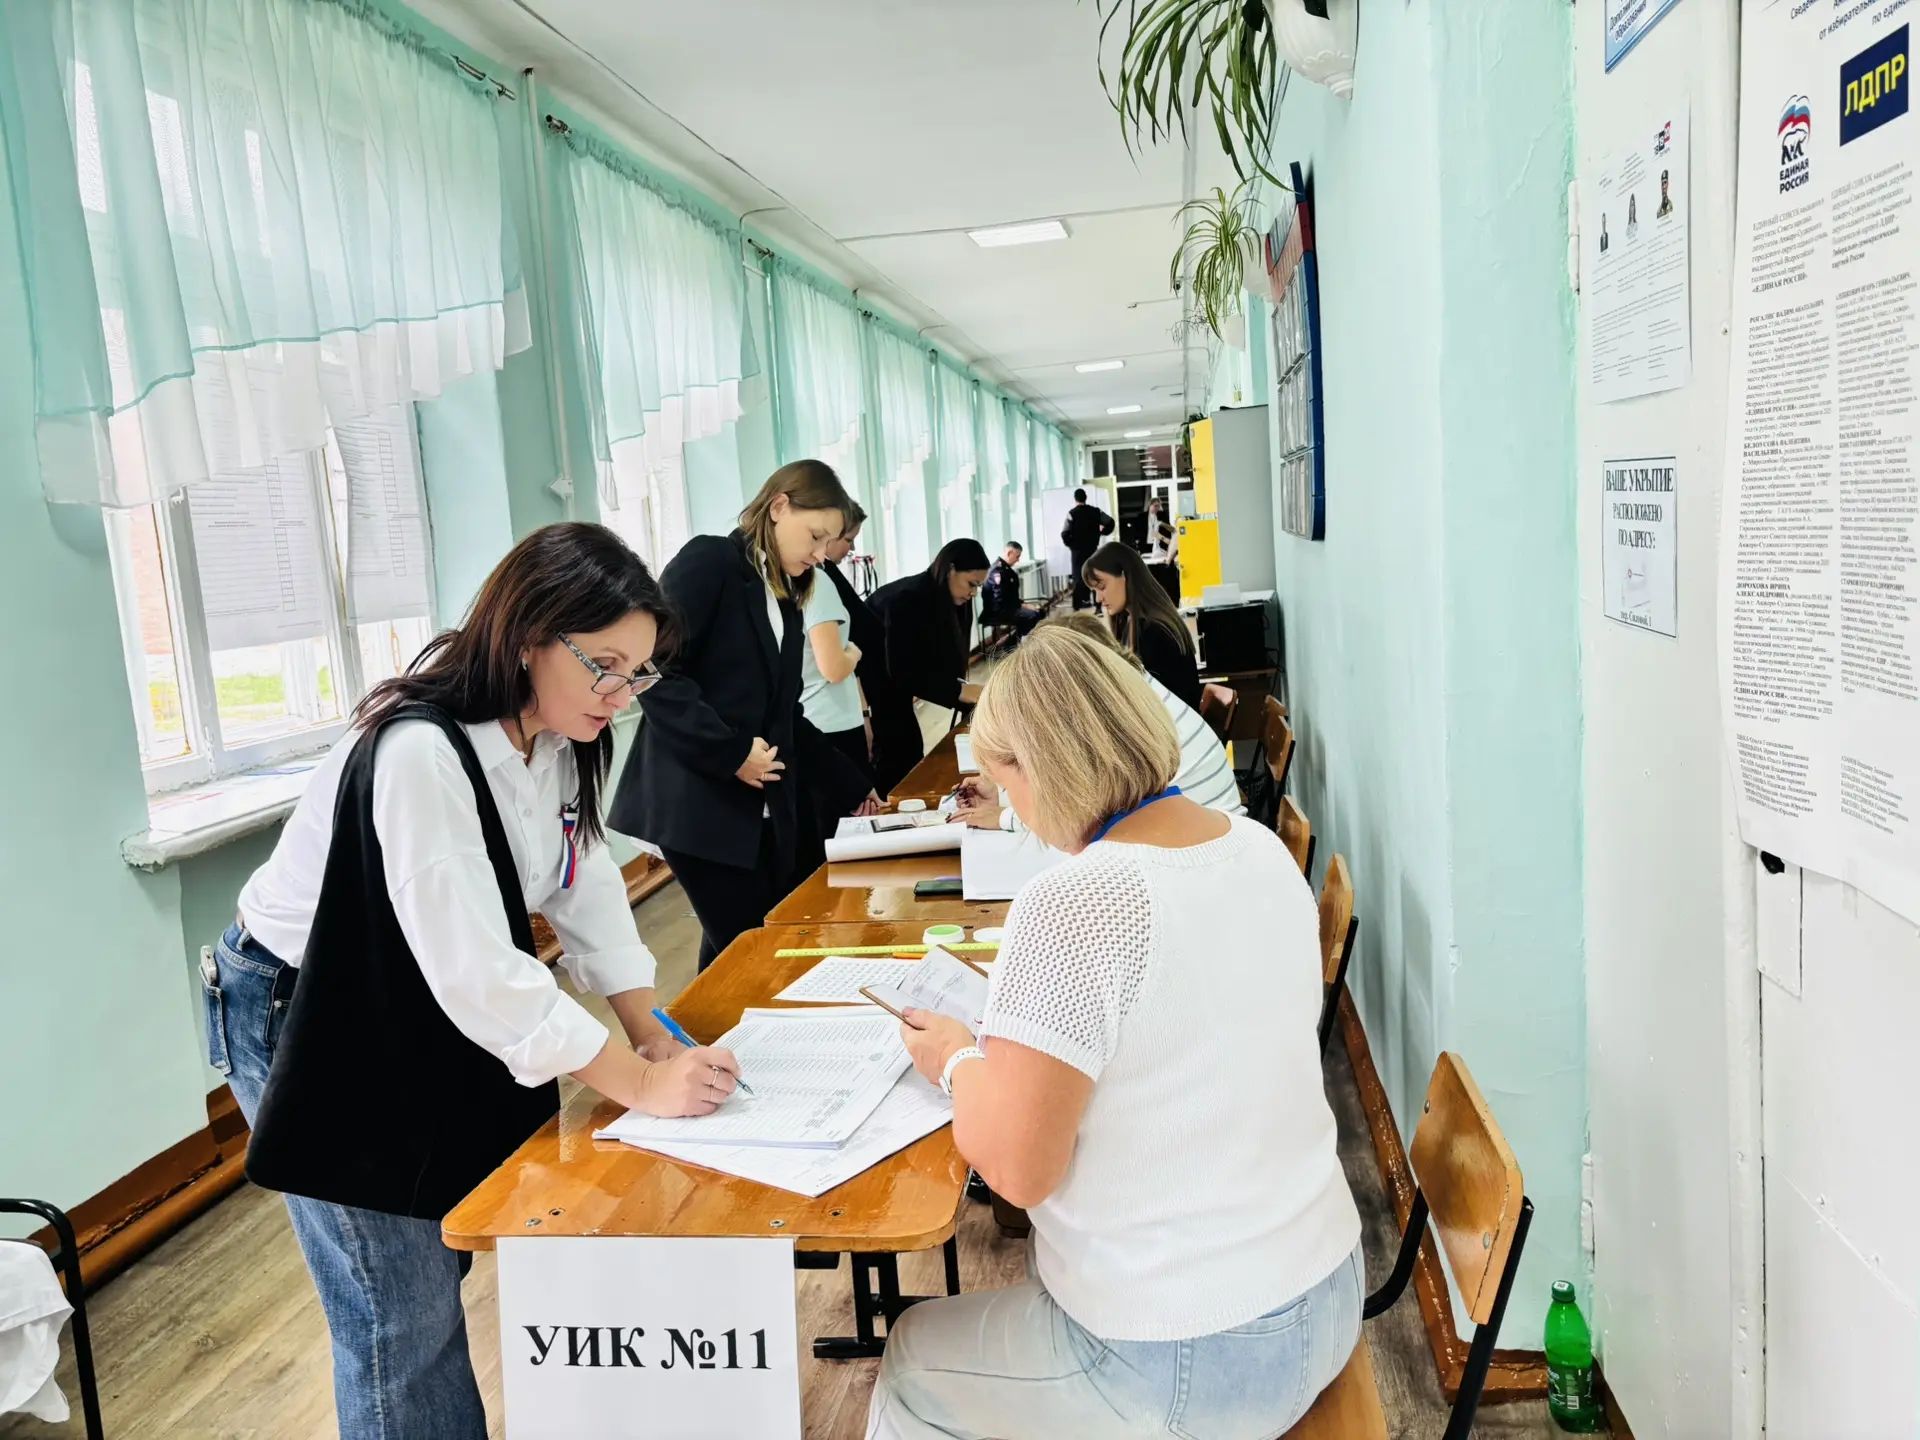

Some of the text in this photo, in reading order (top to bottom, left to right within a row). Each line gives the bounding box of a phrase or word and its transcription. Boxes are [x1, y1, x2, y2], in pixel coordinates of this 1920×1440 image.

[1818, 28, 1827, 40] от
[1844, 53, 1905, 117] ЛДПР
[1779, 158, 1809, 181] ЕДИНАЯ
[1779, 171, 1809, 194] РОССИЯ
[1605, 467, 1674, 492] ВАШЕ УКРЫТИЕ
[522, 1325, 772, 1371] УИК №11
